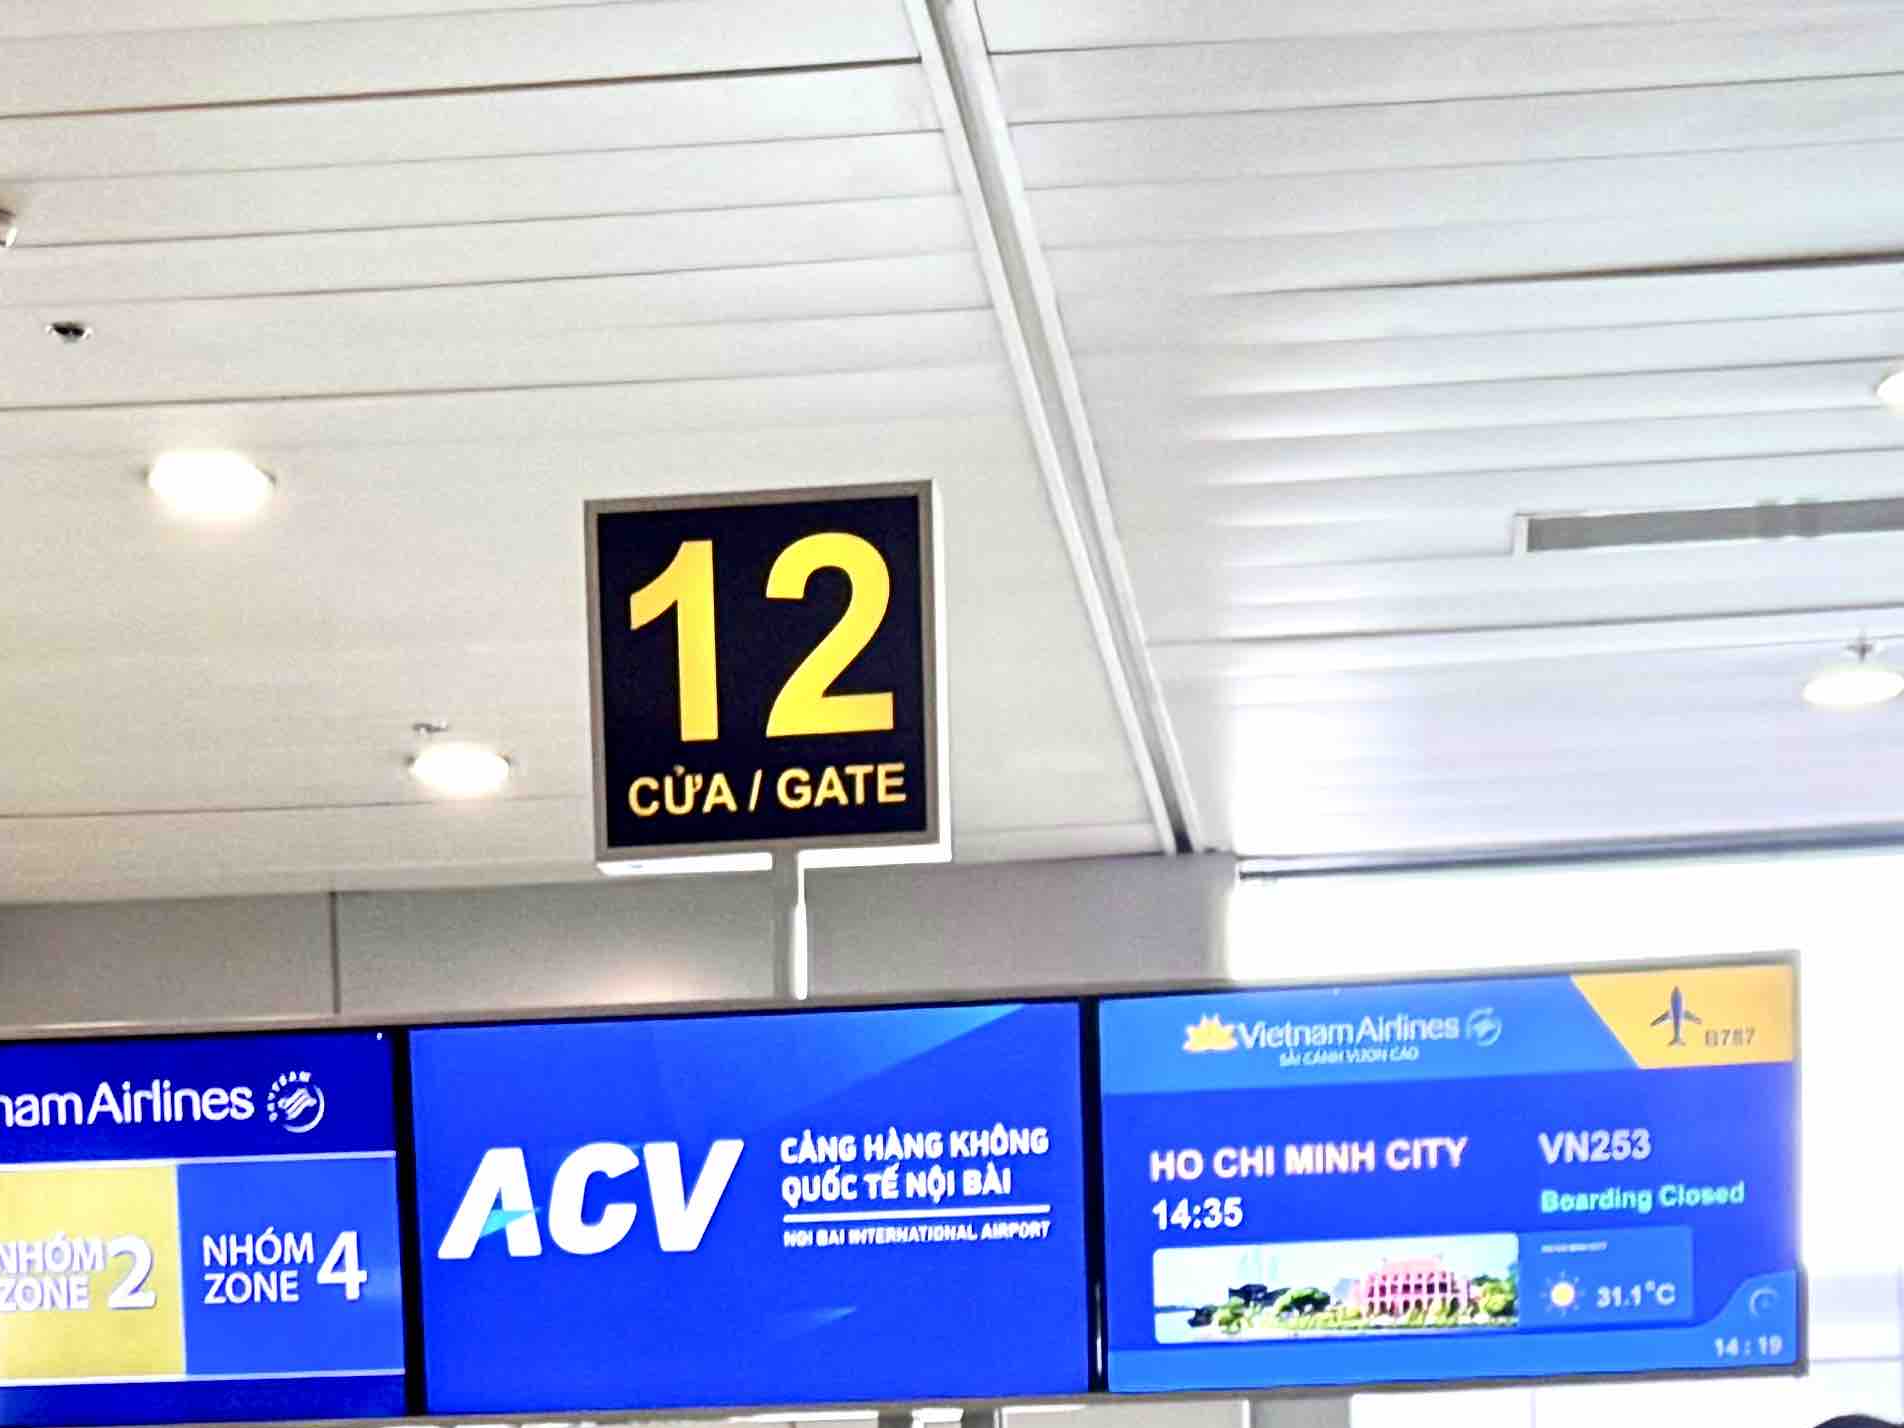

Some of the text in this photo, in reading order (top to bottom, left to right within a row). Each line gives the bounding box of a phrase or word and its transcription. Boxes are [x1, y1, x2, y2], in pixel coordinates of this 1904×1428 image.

[629, 532, 894, 742] 12
[628, 762, 907, 817] CỬA / GATE
[1238, 1014, 1460, 1049] Vietnam Airlines
[87, 1079, 255, 1126] Airlines
[781, 1122, 1049, 1164] CẢNG HÀNG KHÔNG
[1150, 1136, 1468, 1181] HO CHI MINH CITY
[1538, 1128, 1652, 1164] VN253
[438, 1138, 744, 1260] ACV
[782, 1161, 1011, 1208] QUỐC TẾ NỘI BÀI
[1541, 1180, 1745, 1214] Boarding Closed
[848, 1224, 977, 1245] INTERNATIONAL
[981, 1221, 1051, 1241] AIRPORT
[1152, 1197, 1243, 1230] 14:35
[202, 1227, 314, 1269] NHÓM
[317, 1230, 368, 1302] 4
[108, 1235, 158, 1311] 2
[203, 1271, 299, 1305] ZONE
